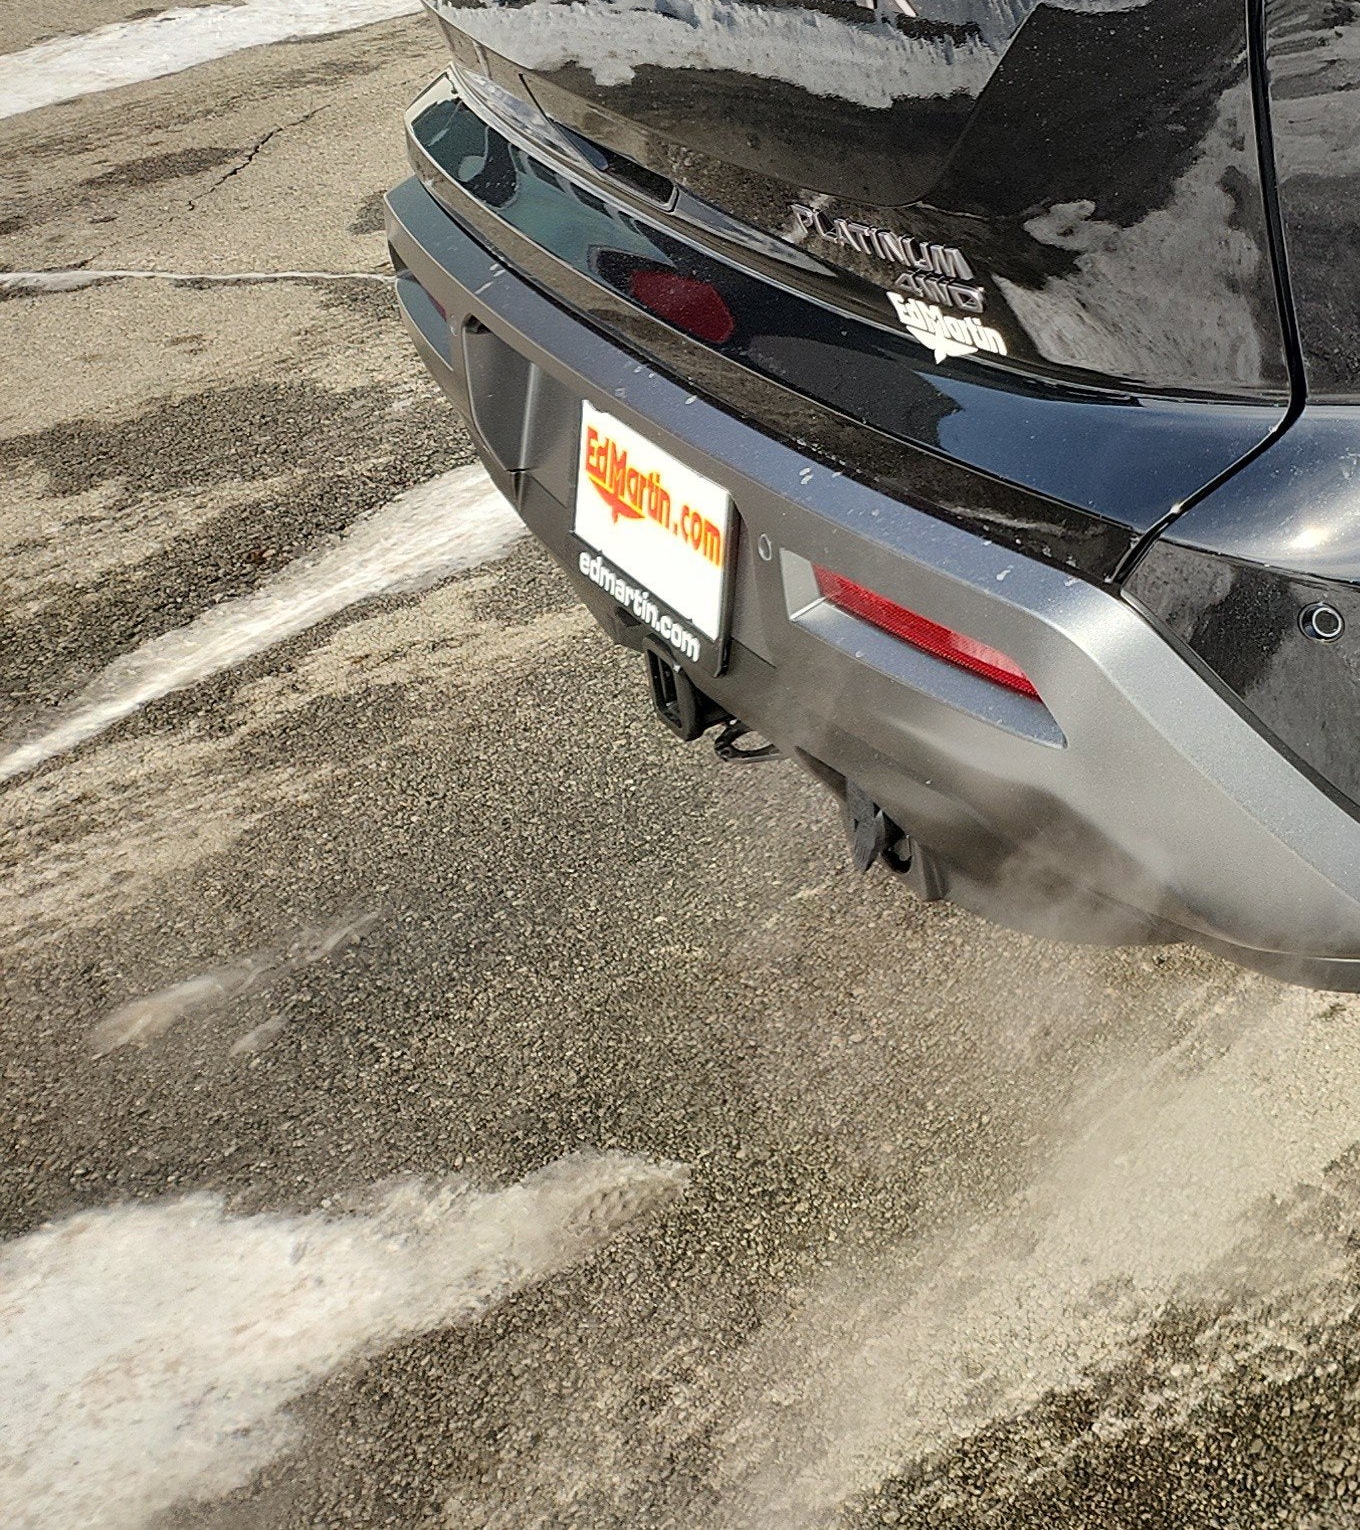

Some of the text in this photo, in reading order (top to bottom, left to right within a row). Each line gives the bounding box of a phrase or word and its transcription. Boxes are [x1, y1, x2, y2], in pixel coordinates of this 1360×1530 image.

[790, 202, 974, 281] PLATINUM
[893, 269, 985, 314] 4WD
[579, 551, 701, 663] edmartin.com
